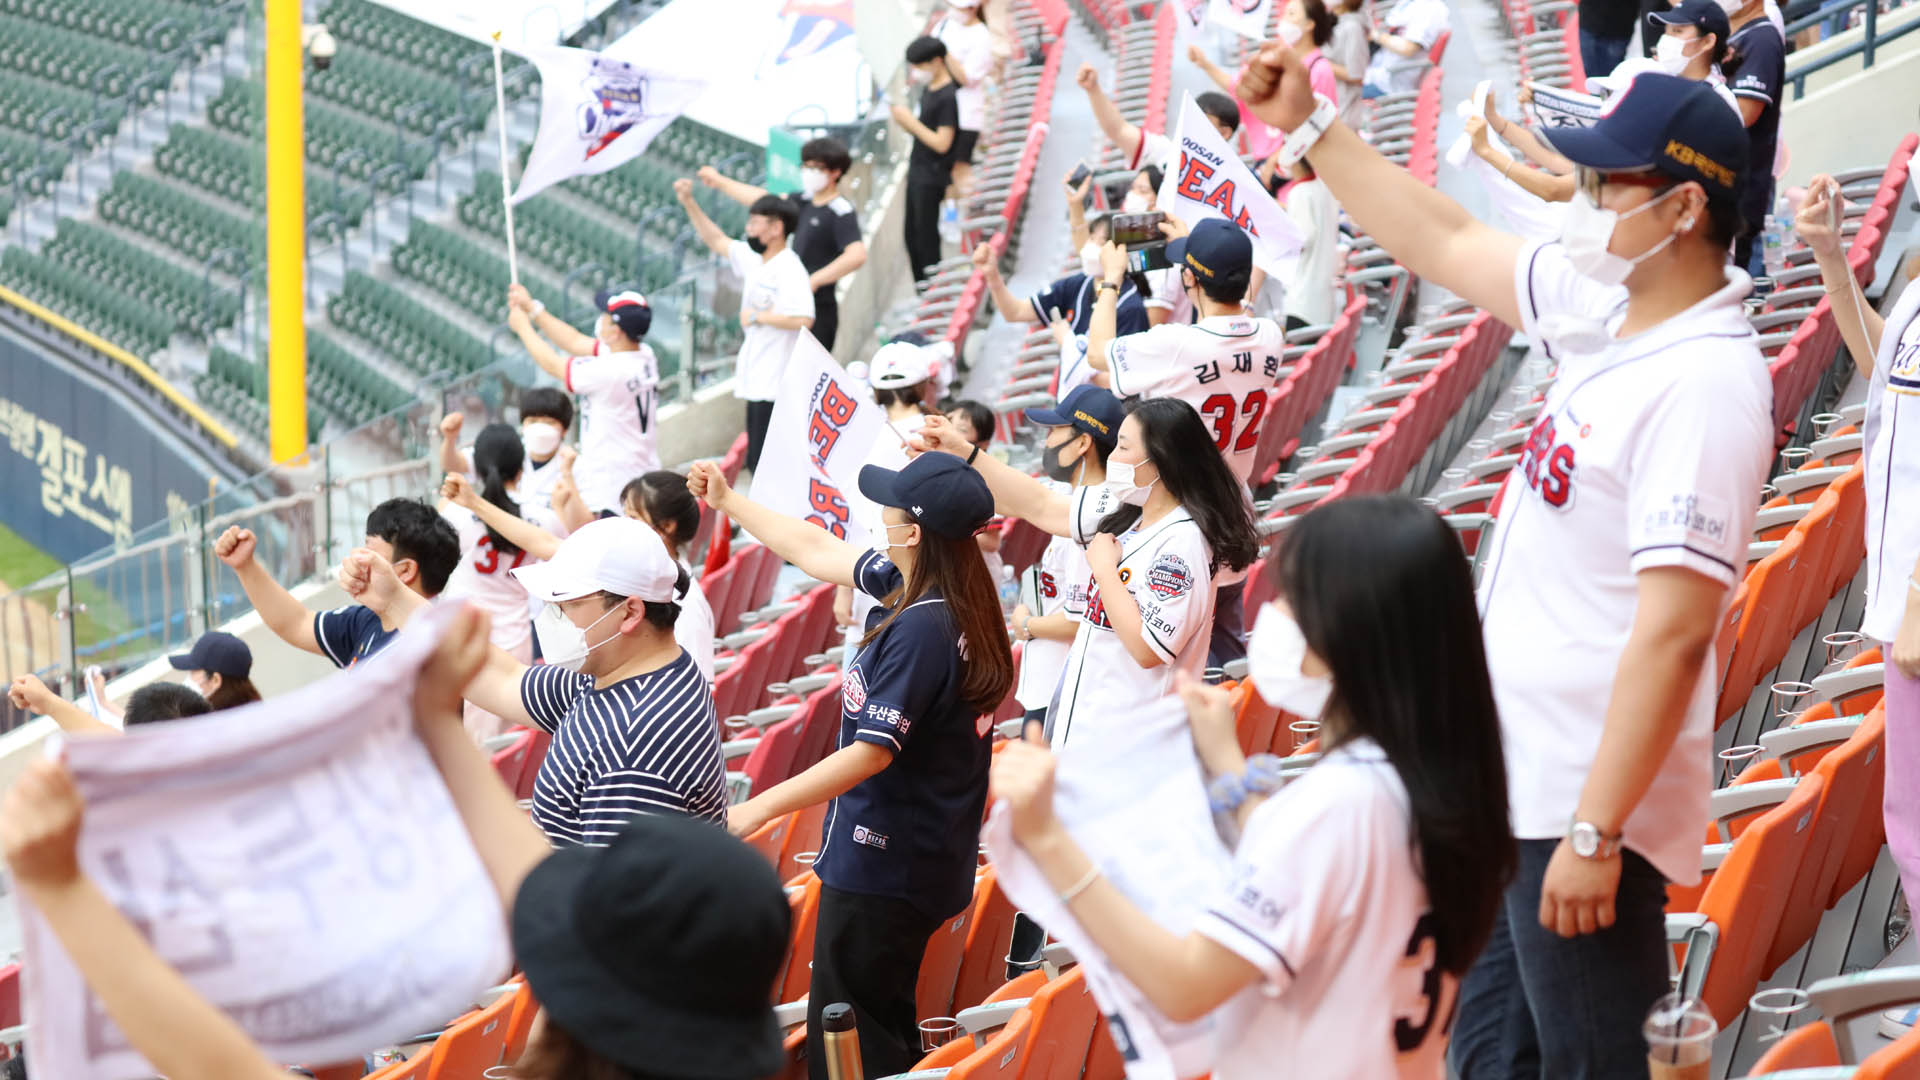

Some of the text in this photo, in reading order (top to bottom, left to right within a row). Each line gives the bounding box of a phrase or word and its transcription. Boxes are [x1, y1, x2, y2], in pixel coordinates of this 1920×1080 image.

[1182, 136, 1225, 167] OOSAN
[1200, 388, 1269, 455] 32
[1147, 566, 1195, 592] CHAMPIONS
[1139, 604, 1177, 637] 프라코어
